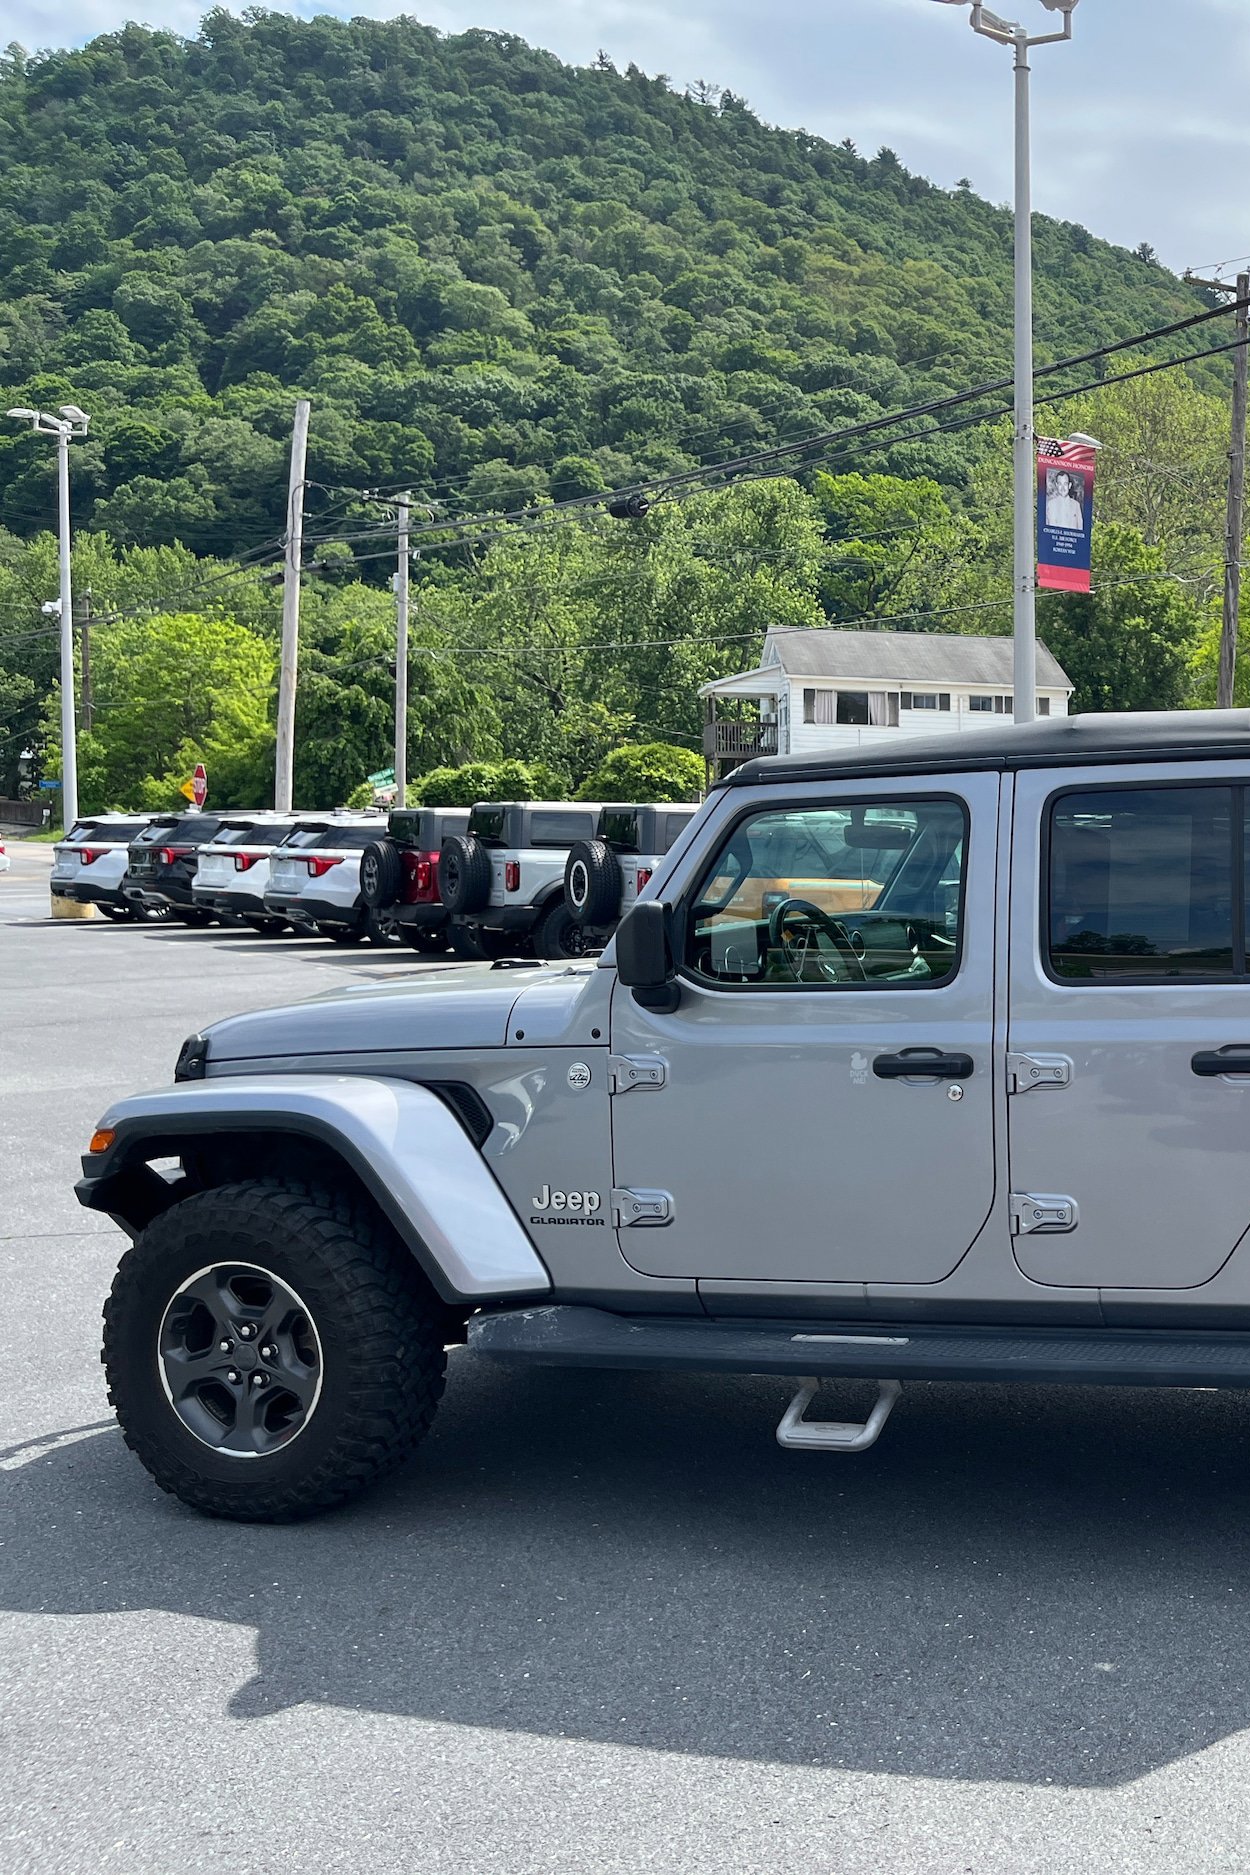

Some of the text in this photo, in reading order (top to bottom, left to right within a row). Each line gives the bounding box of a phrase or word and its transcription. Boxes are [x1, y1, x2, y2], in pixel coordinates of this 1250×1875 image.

[1038, 457, 1072, 467] DUNCANNON
[194, 777, 206, 794] STOP
[532, 1184, 601, 1216] Jeep
[530, 1216, 605, 1226] GLADIATOR
